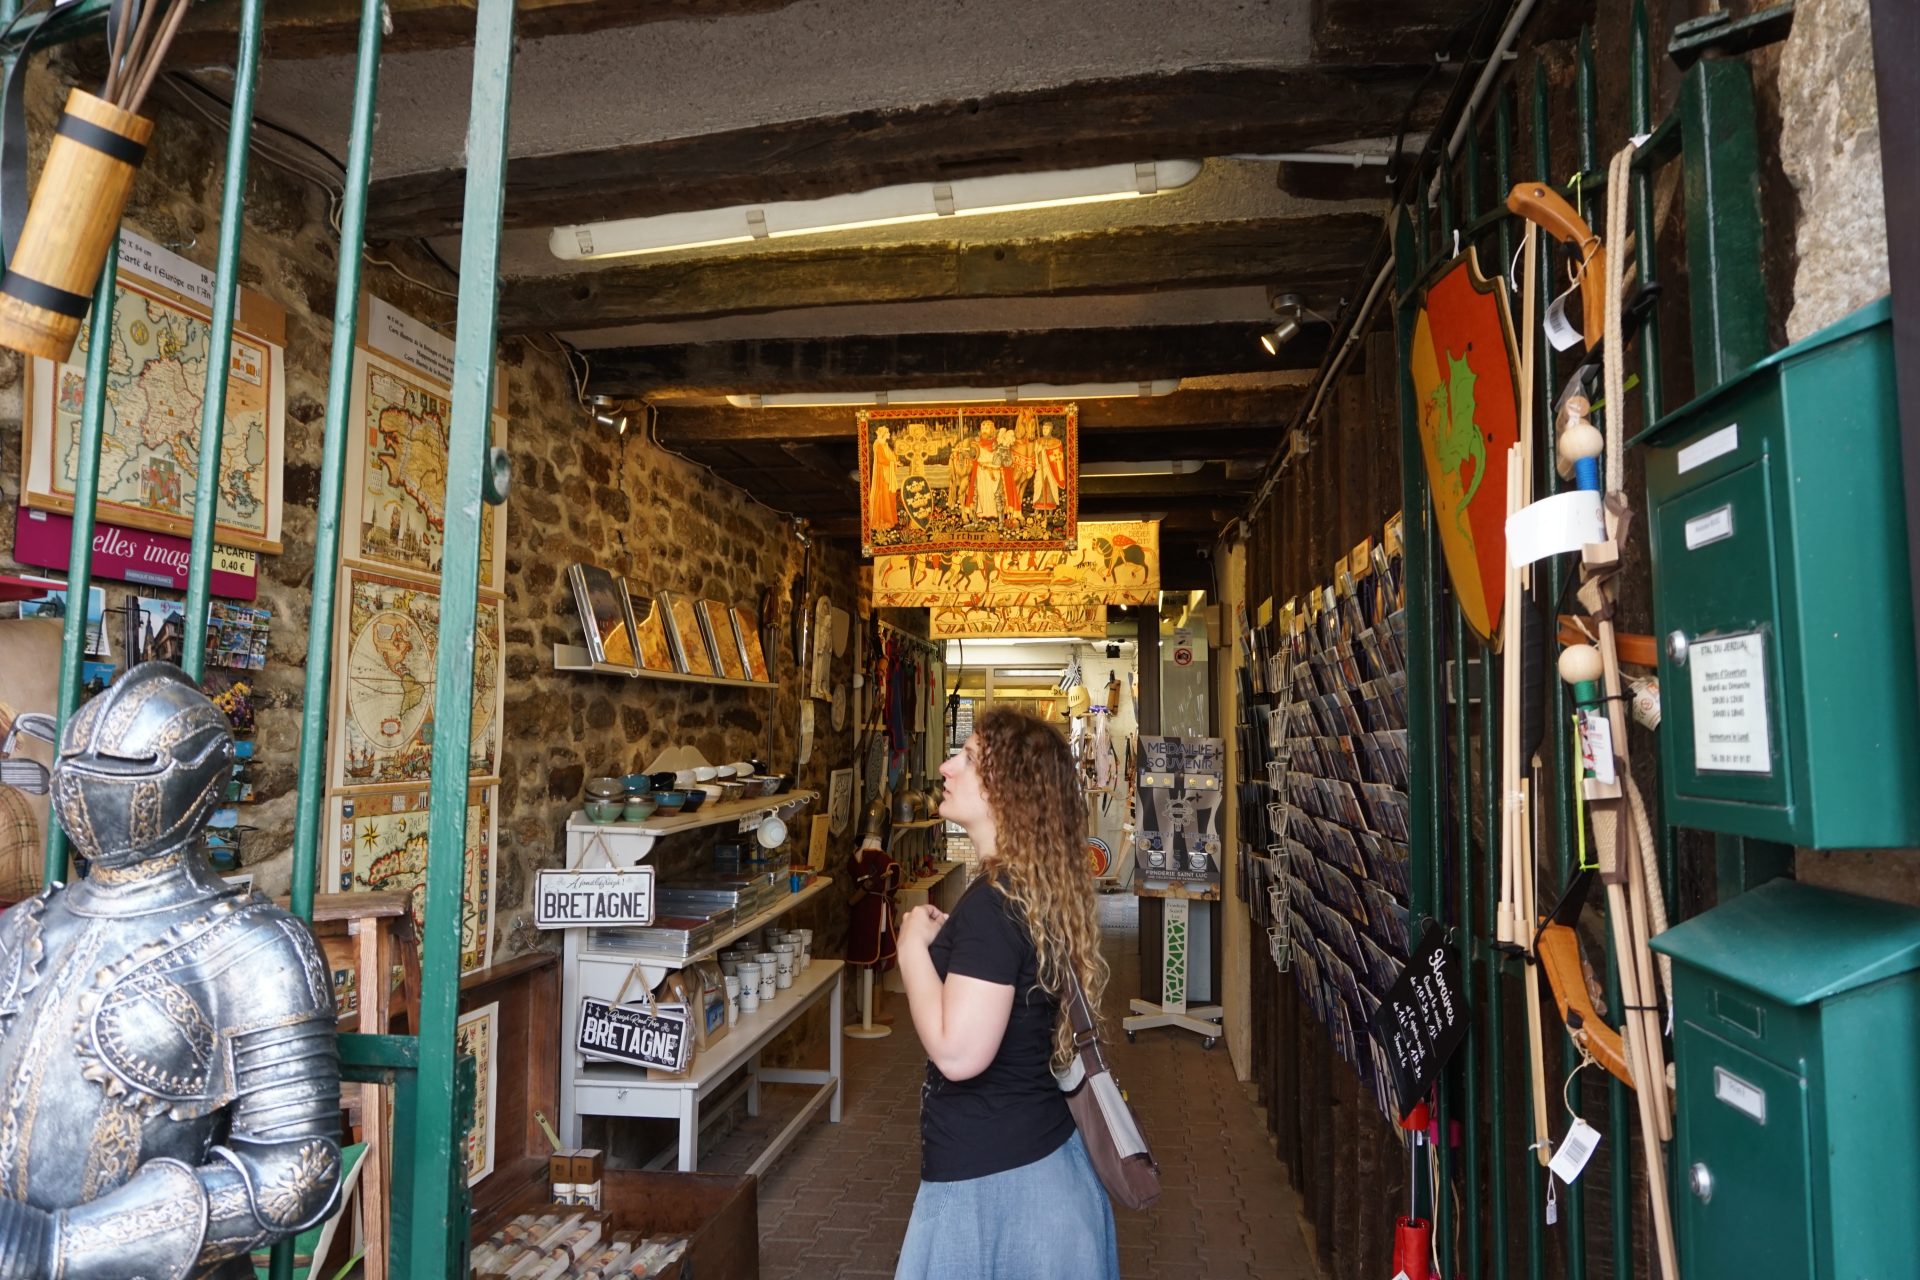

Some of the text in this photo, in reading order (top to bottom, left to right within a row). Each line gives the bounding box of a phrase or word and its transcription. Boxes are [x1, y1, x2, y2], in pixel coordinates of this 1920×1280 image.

[118, 250, 140, 267] Carte
[143, 262, 152, 273] de
[93, 527, 137, 559] elles
[226, 545, 255, 561] CARTE
[221, 558, 246, 573] 0,40 €
[1147, 757, 1213, 769] SOUVENIR
[544, 891, 646, 919] BRETAGNE
[1428, 948, 1455, 1027] Horaires
[583, 1016, 679, 1062] BRETAGNE
